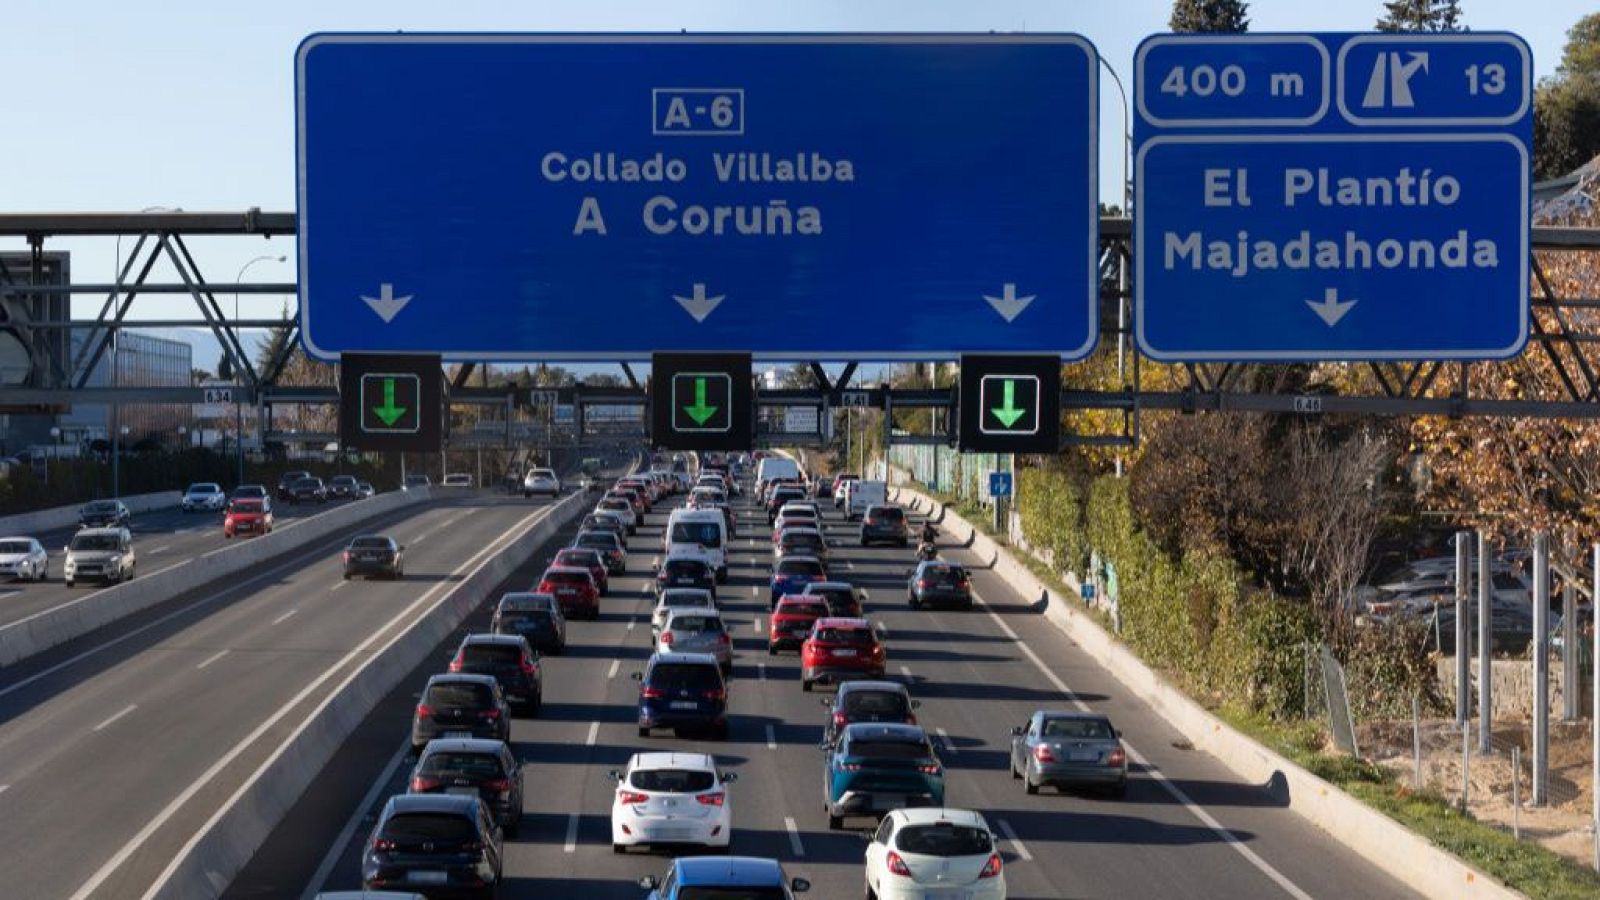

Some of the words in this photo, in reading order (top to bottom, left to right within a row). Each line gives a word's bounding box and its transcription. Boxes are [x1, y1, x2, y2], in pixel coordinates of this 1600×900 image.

[1161, 65, 1246, 97] 400
[1271, 72, 1304, 96] m
[1465, 63, 1506, 95] 13
[665, 96, 734, 128] A-6
[541, 152, 687, 182] Collado
[713, 153, 855, 182] Villalba
[1204, 168, 1251, 207] El
[1285, 168, 1461, 207] Plantío
[573, 196, 607, 235] A
[643, 196, 823, 235] Coruña
[1164, 230, 1499, 278] Majadahonda
